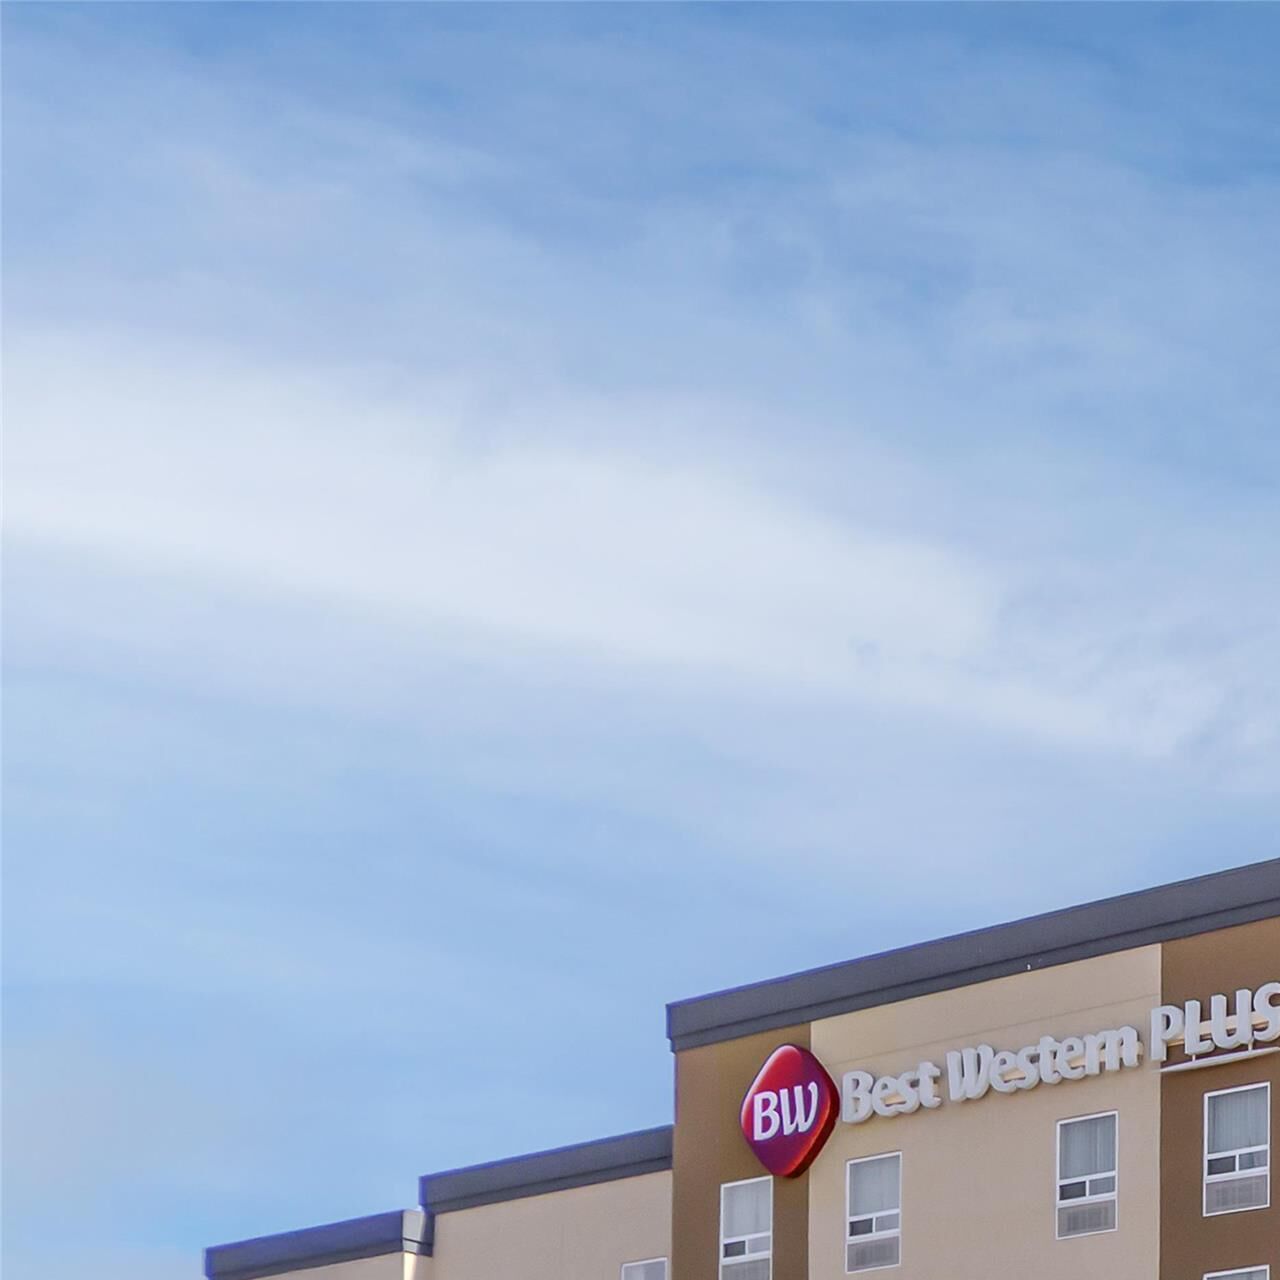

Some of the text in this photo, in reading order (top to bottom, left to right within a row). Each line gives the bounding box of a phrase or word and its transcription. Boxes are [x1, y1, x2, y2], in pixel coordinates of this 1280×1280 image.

[753, 1081, 819, 1142] BW
[841, 1070, 942, 1124] Best
[946, 1025, 1140, 1101] Western
